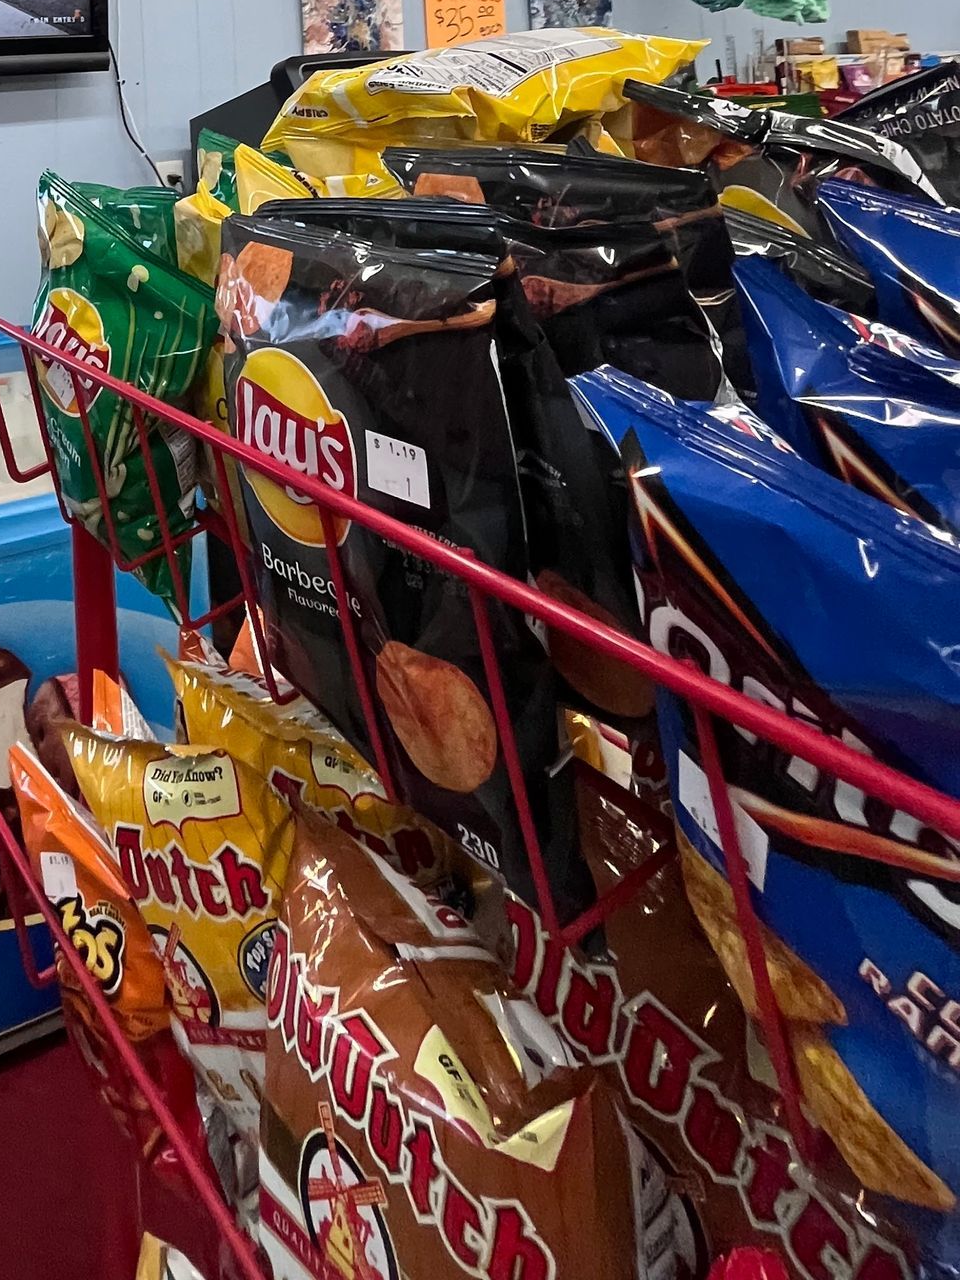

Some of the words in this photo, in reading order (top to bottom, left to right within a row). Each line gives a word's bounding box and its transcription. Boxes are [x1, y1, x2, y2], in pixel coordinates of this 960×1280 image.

[50, 417, 82, 468] Cream
[456, 822, 500, 869] 230
[115, 822, 272, 922] Dutch
